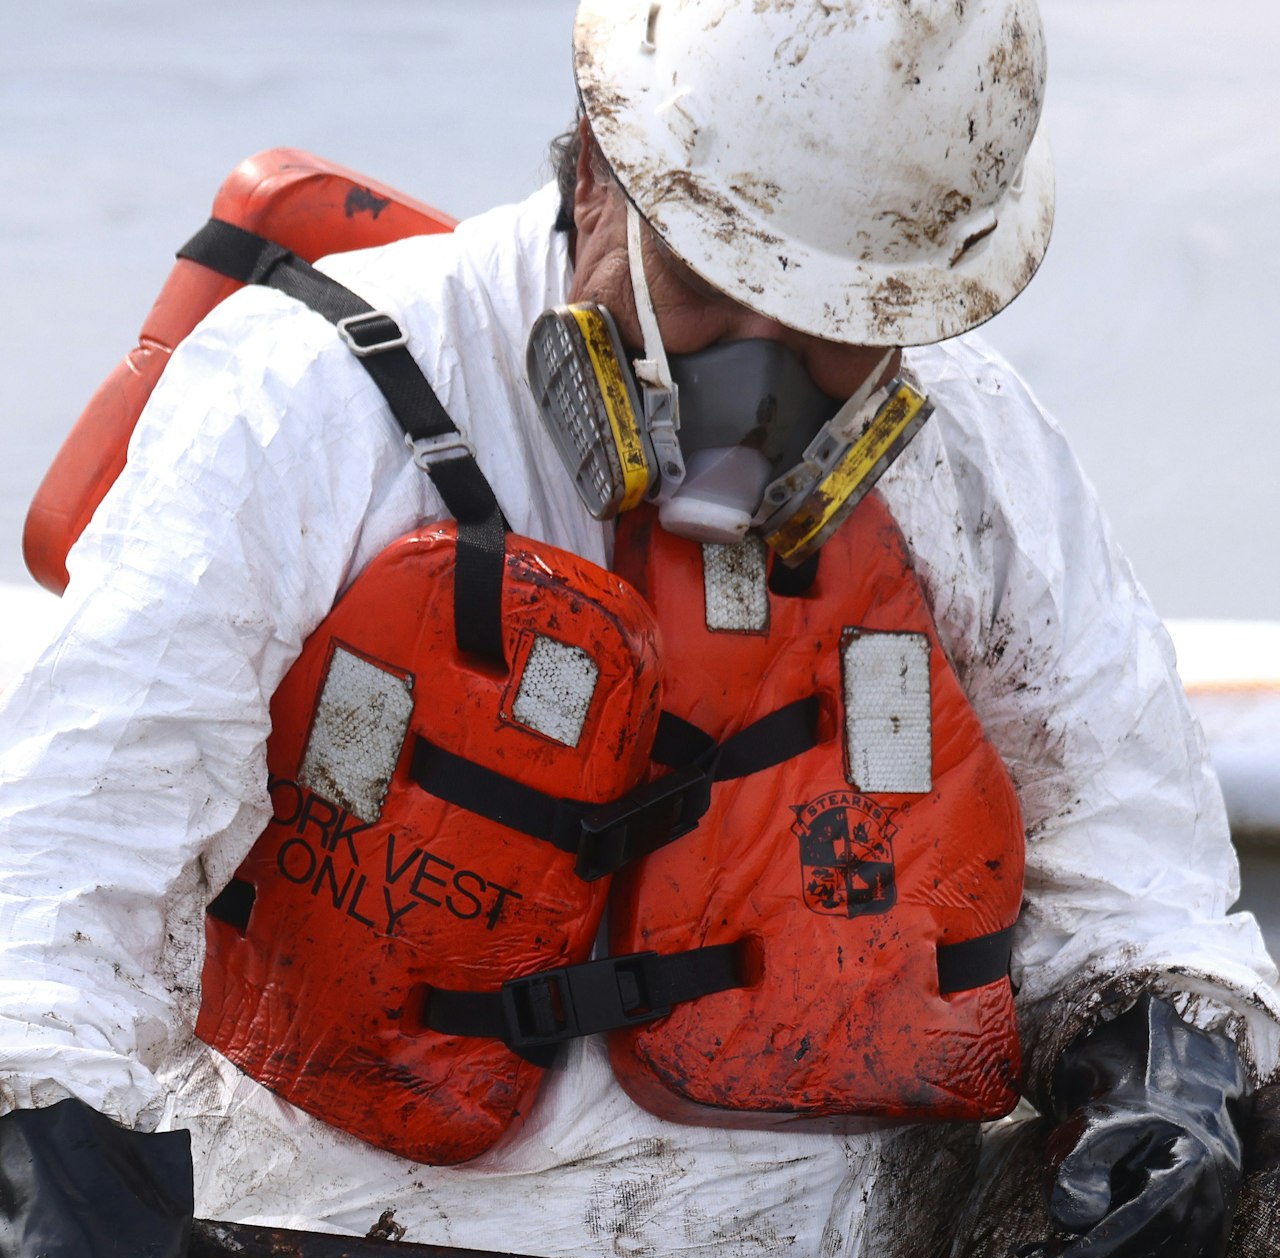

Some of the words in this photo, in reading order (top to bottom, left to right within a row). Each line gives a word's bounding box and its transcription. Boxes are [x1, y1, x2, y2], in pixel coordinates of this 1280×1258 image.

[267, 774, 370, 867] ORK
[386, 833, 523, 931] VEST
[807, 793, 882, 819] STEARNS
[277, 838, 419, 935] ONLY
